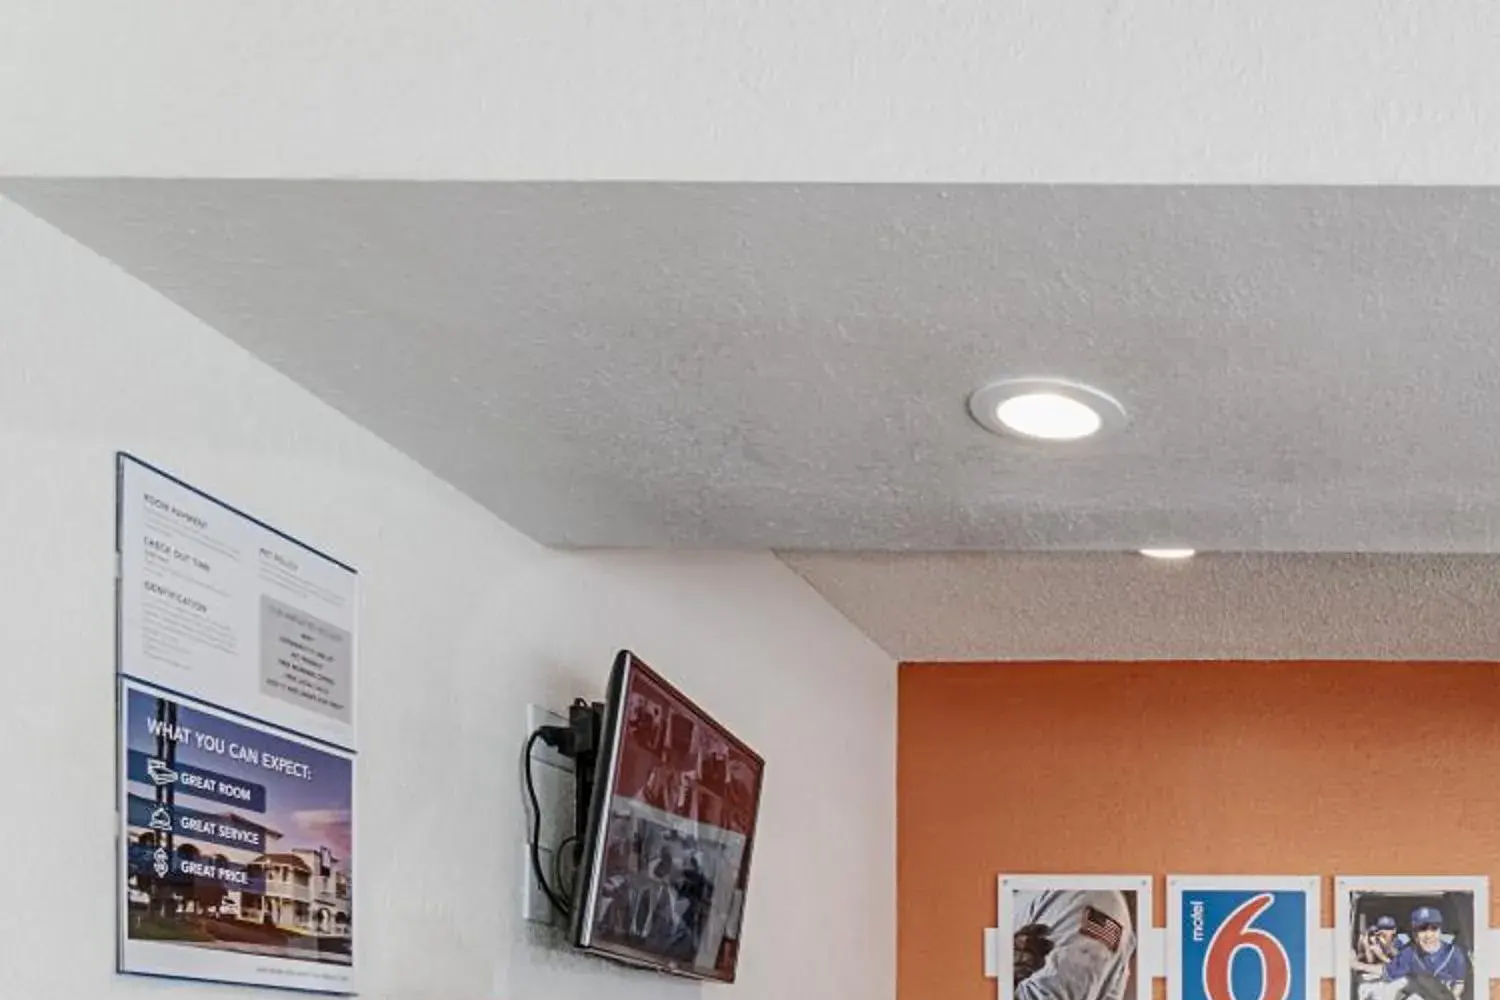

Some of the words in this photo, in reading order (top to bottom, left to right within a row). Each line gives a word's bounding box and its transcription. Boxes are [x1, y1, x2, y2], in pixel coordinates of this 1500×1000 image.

[147, 716, 191, 745] WHAT
[195, 731, 225, 754] YOU
[229, 743, 258, 765] CAN
[261, 753, 312, 780] EXPECT:
[180, 773, 217, 793] GREAT
[219, 783, 251, 800] ROOM
[180, 816, 217, 835] GREAT
[218, 825, 260, 845] SERVICE
[180, 861, 217, 879] GREAT
[218, 869, 248, 885] PRICE
[1190, 901, 1204, 942] motel
